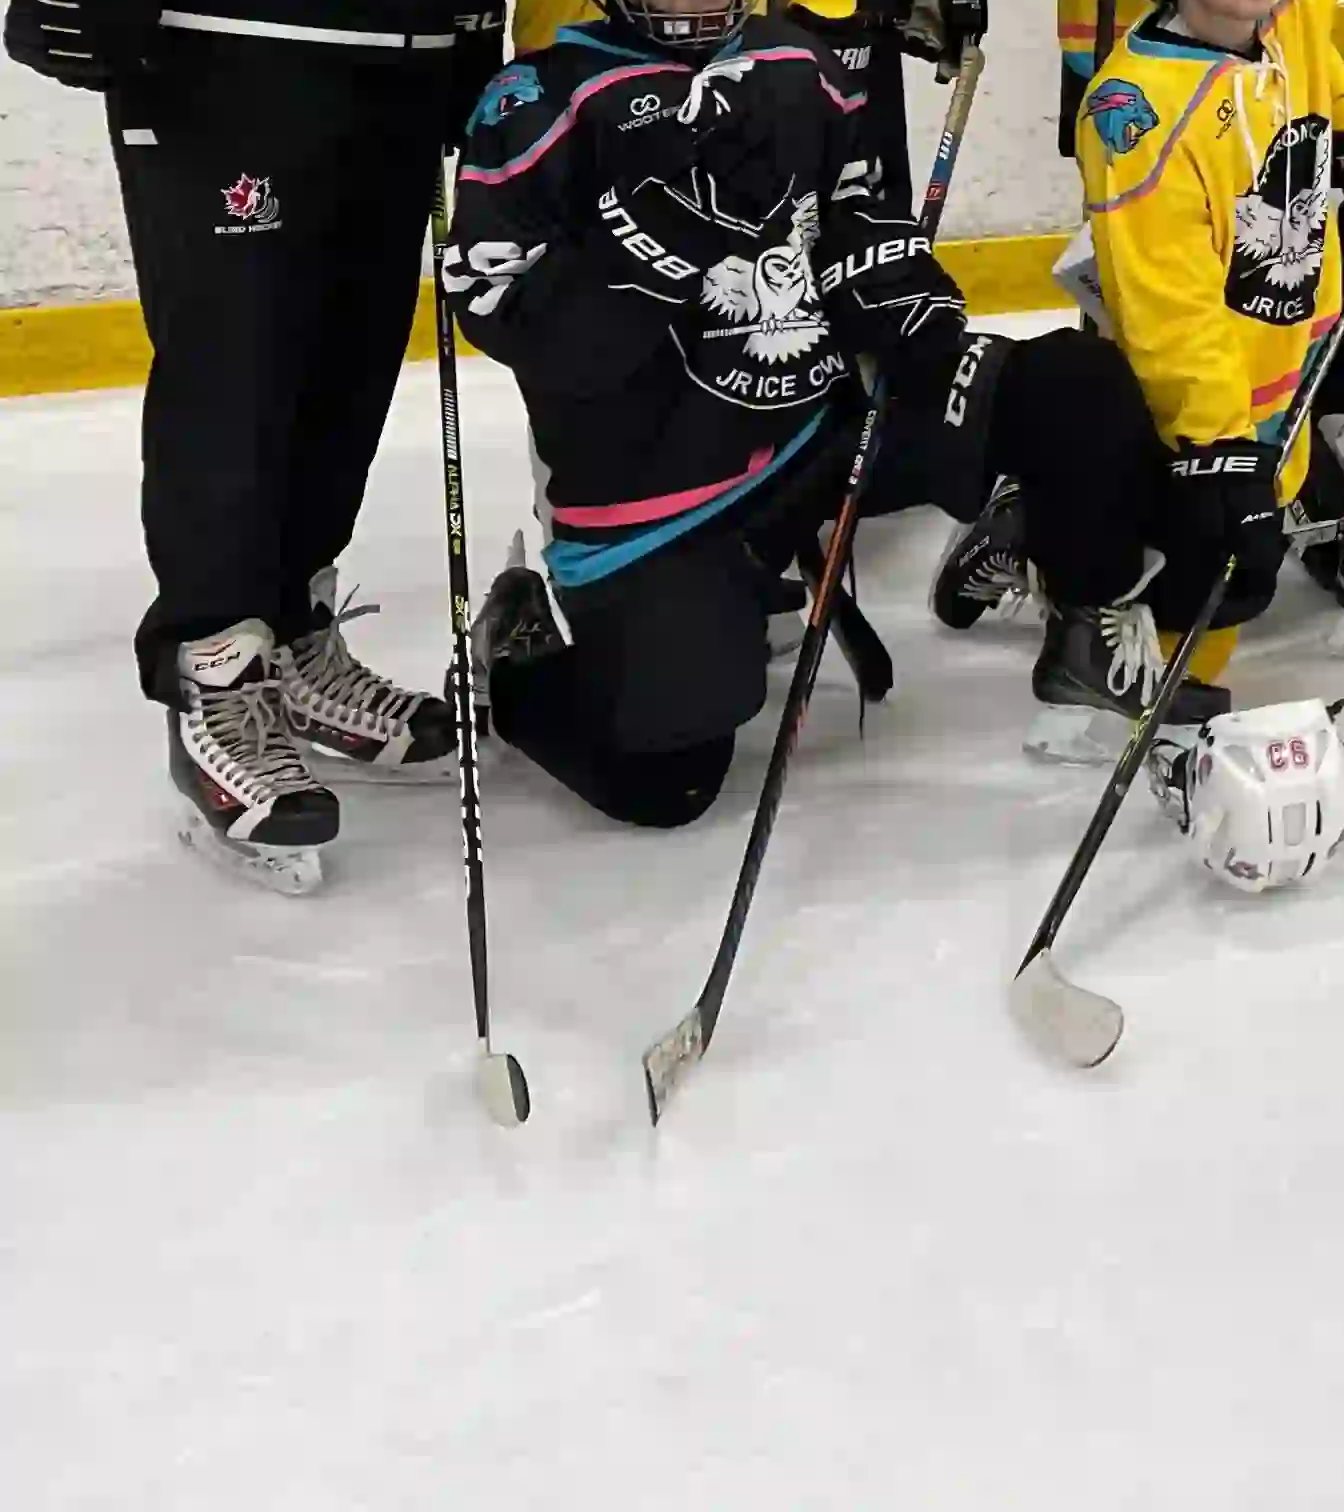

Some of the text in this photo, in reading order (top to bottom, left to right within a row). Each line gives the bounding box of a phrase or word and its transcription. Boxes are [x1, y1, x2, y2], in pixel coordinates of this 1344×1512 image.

[598, 185, 701, 282] BAUE
[819, 234, 936, 296] AUER
[1242, 295, 1273, 317] JR
[715, 352, 848, 399] JR ICE OW
[1168, 455, 1259, 477] RUE
[193, 651, 242, 673] CCM
